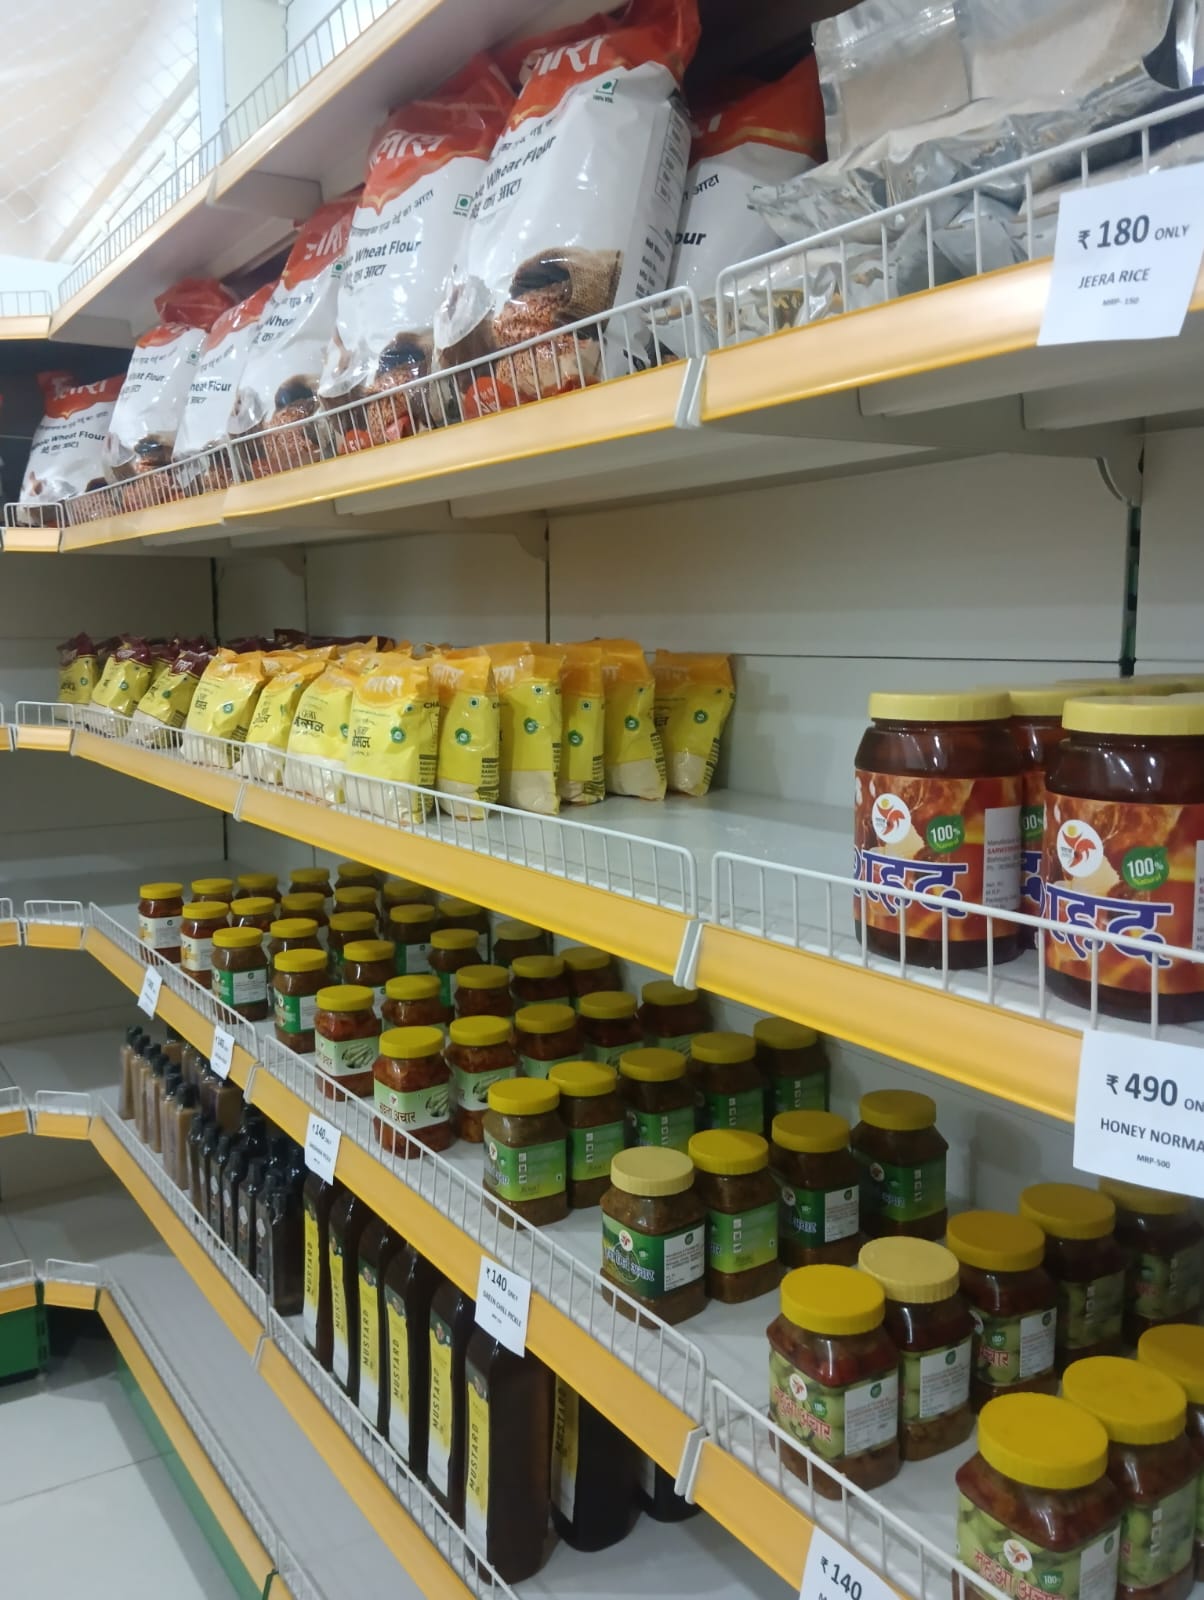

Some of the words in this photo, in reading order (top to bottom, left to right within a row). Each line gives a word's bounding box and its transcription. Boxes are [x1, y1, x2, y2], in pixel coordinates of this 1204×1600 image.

[1097, 214, 1150, 248] 180
[1154, 224, 1190, 241] ONLY
[355, 242, 387, 263] Wheat
[389, 241, 422, 256] Flour
[1078, 271, 1115, 290] JEERA
[1118, 268, 1151, 282] RICE
[208, 380, 232, 392] Flour
[78, 430, 106, 441] Flour
[930, 824, 961, 843] 100%
[1127, 857, 1165, 878] 100%
[1106, 1074, 1119, 1095] ₹
[1125, 1073, 1178, 1107] 490
[1100, 1117, 1146, 1139] HONEY
[1150, 1129, 1204, 1154] NORMA
[1136, 1154, 1171, 1170] MRP-500
[491, 1269, 507, 1292] 140
[507, 1311, 522, 1328] PICKLE
[392, 1339, 400, 1399] MUSTARD
[431, 1367, 440, 1430] MUSTARD
[470, 1423, 479, 1490] MUSTARD
[831, 1564, 862, 1600] 140
